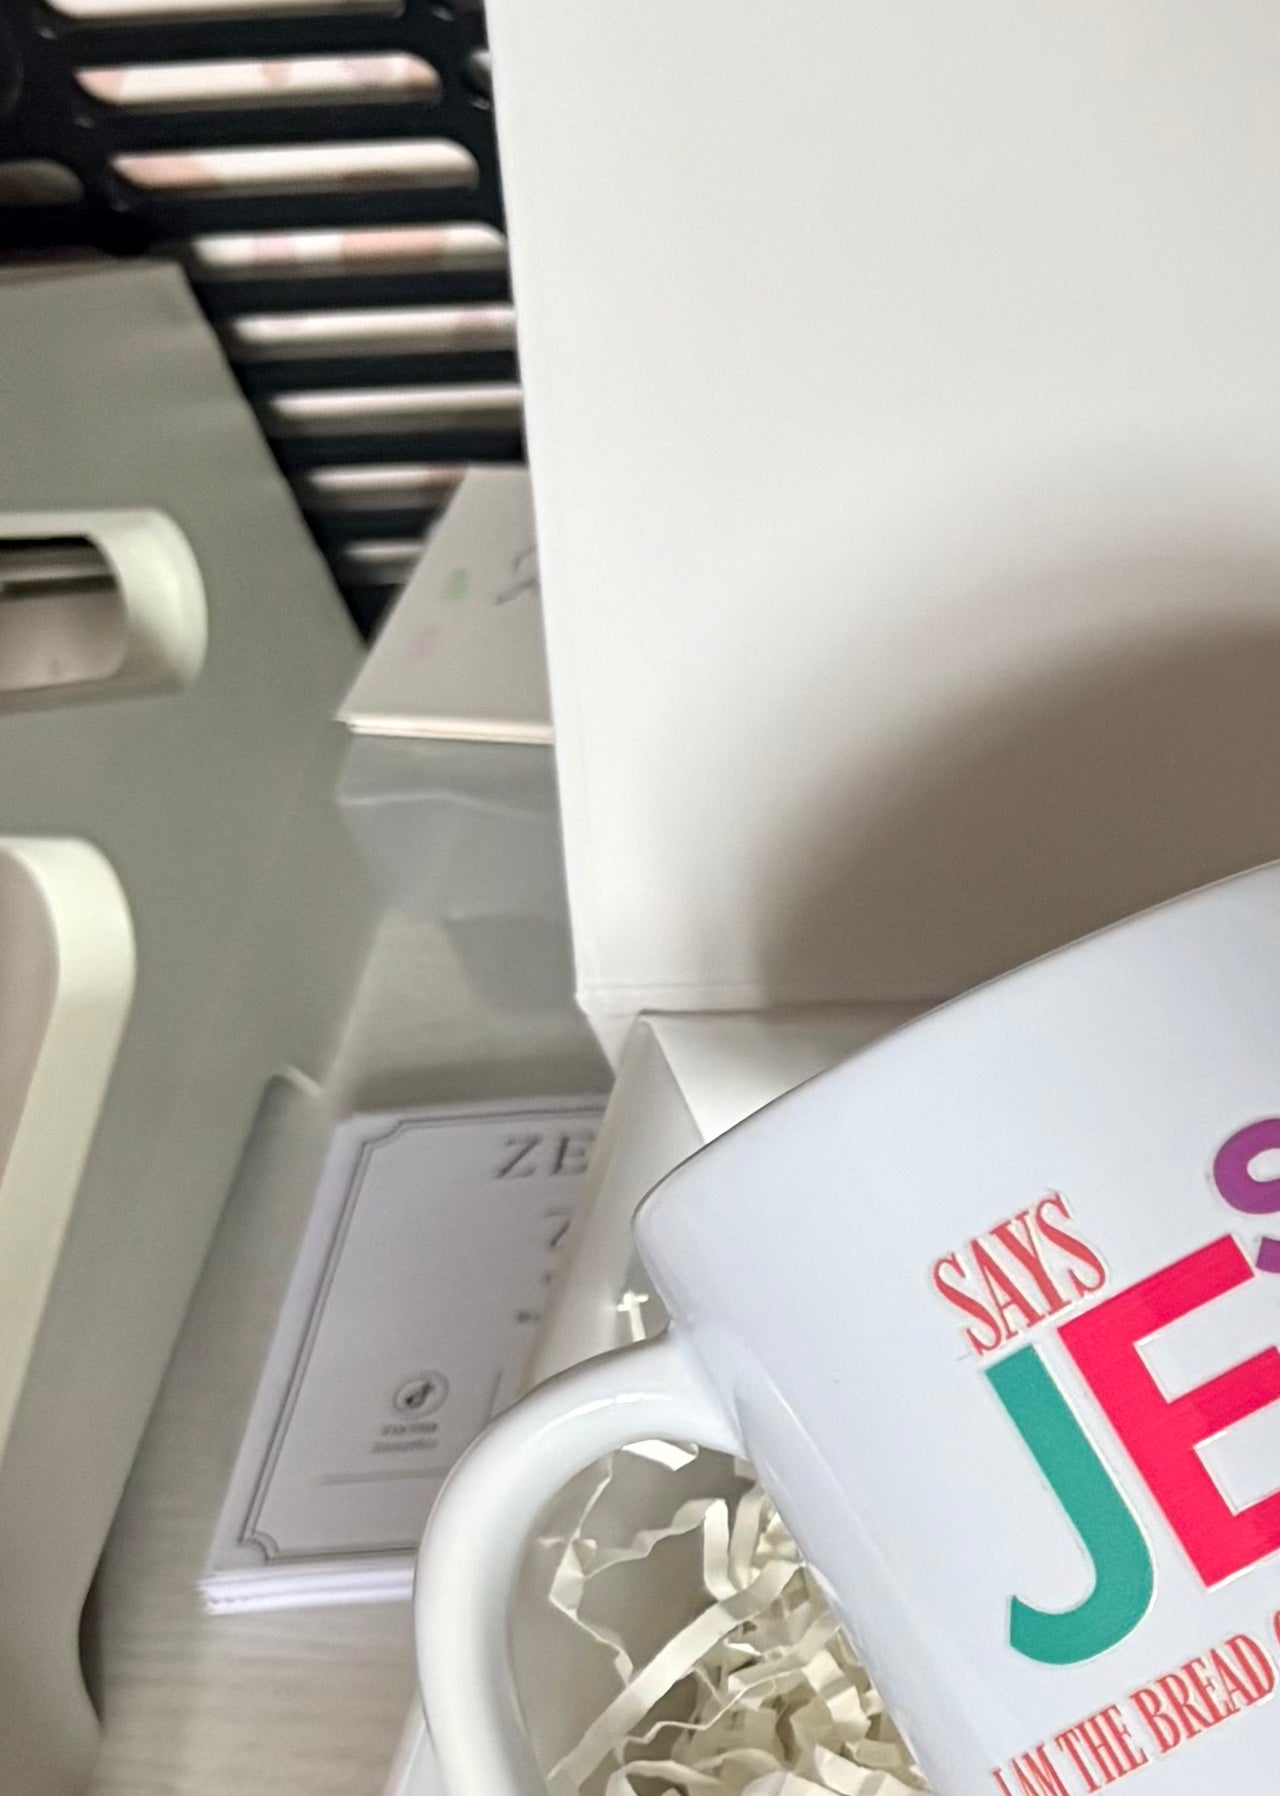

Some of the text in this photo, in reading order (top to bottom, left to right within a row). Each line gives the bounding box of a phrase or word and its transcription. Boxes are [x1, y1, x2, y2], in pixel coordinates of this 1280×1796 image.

[933, 1193, 1107, 1354] SAYS
[1054, 1704, 1149, 1793] THE
[1129, 1633, 1276, 1754] BREAD
